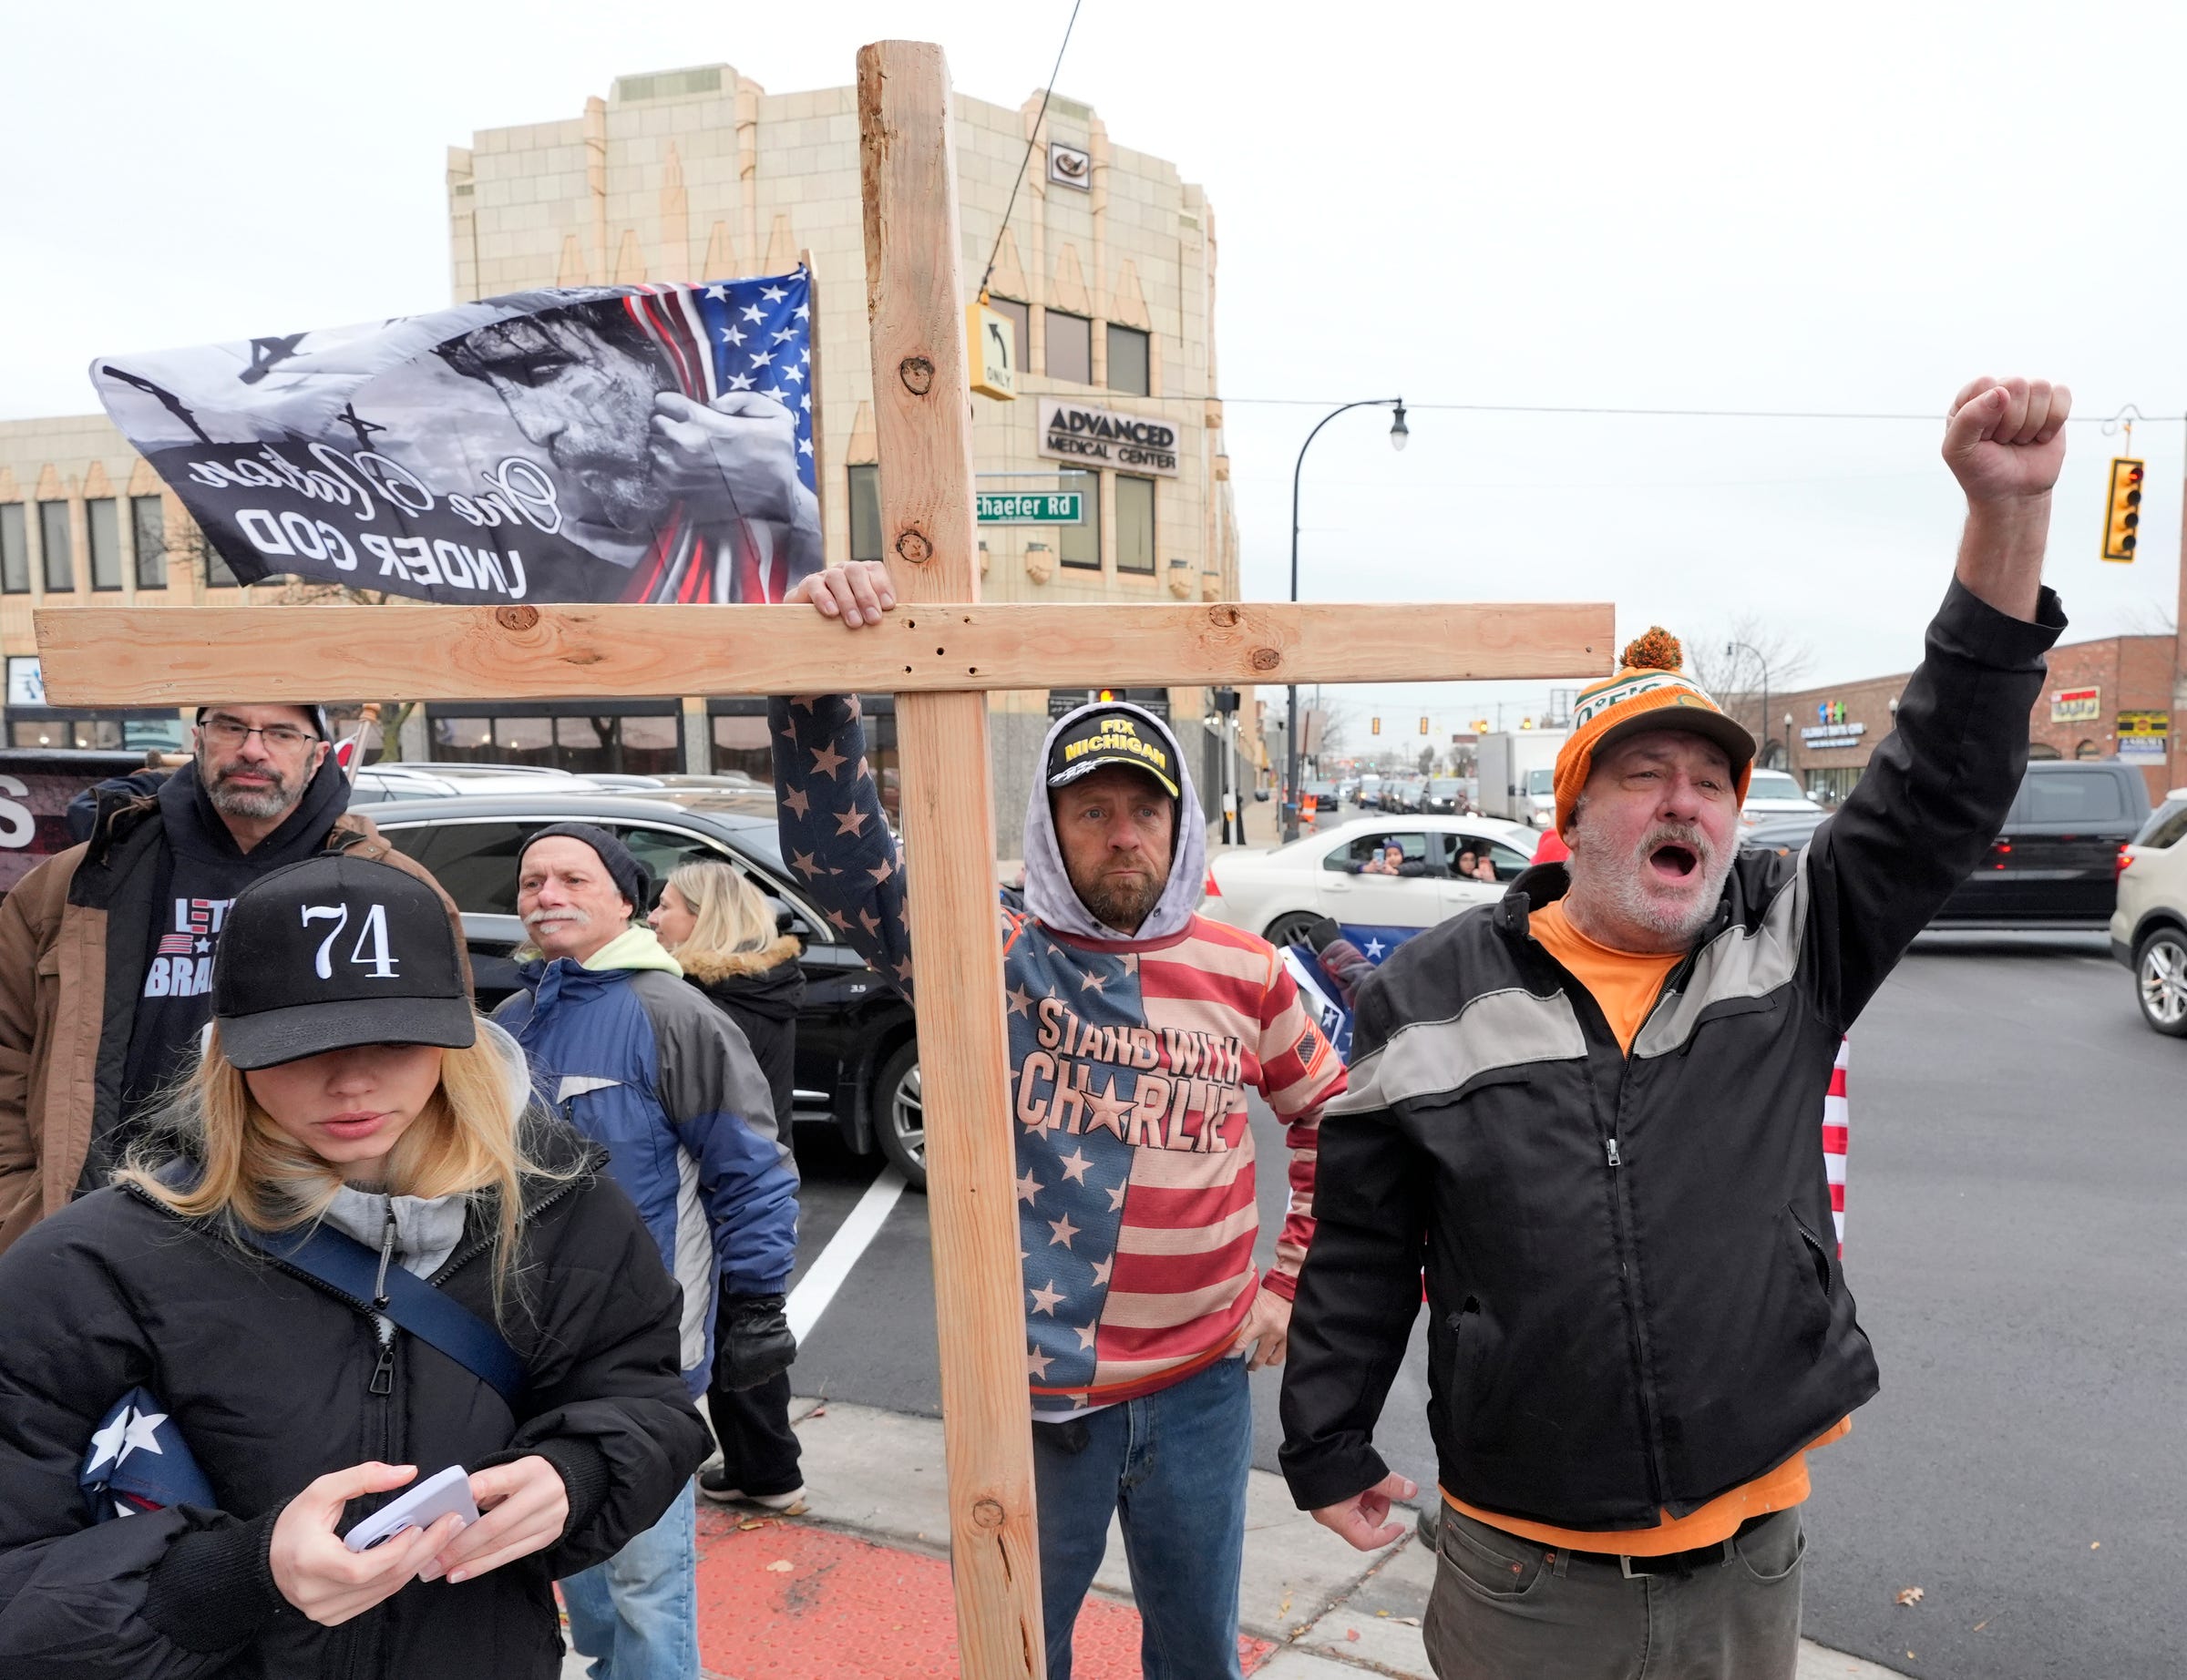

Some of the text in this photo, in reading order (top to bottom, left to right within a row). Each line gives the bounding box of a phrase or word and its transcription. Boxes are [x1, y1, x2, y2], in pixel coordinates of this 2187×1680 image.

[987, 365, 1012, 389] ONLY
[1050, 408, 1175, 447] ADVANCED
[1048, 435, 1176, 470] MEDICAL CENTER
[977, 496, 1071, 516] chaefer Rd
[1100, 719, 1136, 736] FIX
[1064, 733, 1166, 770] MICHIGAN
[175, 898, 237, 935] LET'
[301, 902, 400, 980] 74
[144, 957, 215, 998] BRA
[1037, 996, 1243, 1085] STAND WITH
